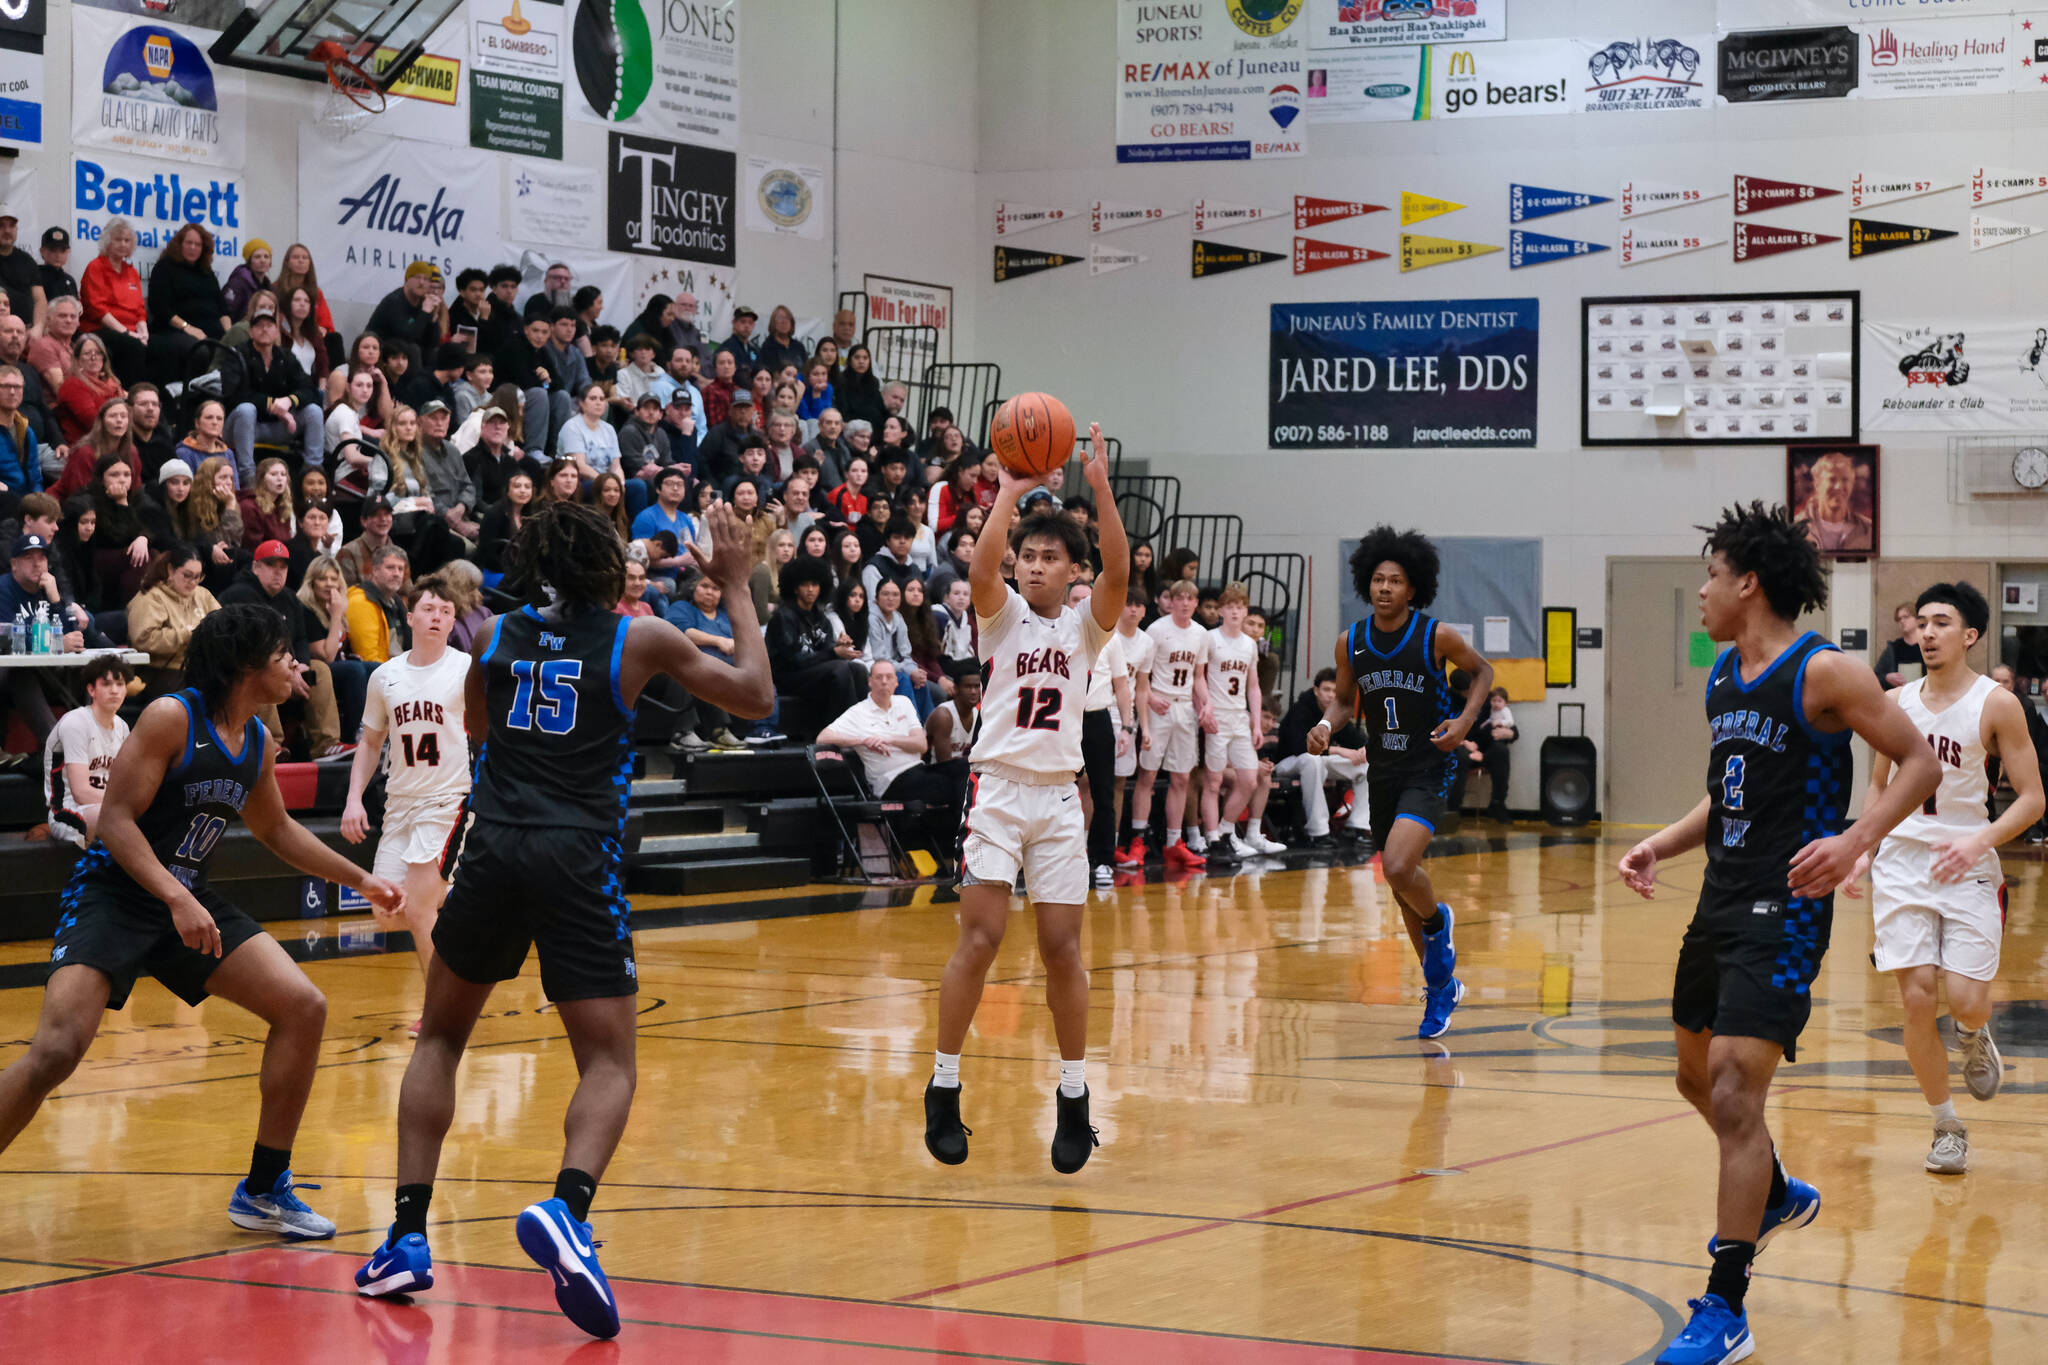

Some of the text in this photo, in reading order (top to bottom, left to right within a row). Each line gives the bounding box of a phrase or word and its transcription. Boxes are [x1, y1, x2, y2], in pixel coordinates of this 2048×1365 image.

[660, 0, 735, 44] JONES
[1138, 5, 1201, 24] JUNEAU
[488, 35, 497, 48] EL
[1136, 25, 1202, 44] SPORTS!
[148, 45, 169, 67] NAPA
[1903, 37, 2005, 61] Healing Hand
[1124, 60, 1210, 83] RE/MAX
[1214, 58, 1233, 77] of
[1238, 57, 1300, 79] Juneau
[9, 80, 29, 93] COOL
[475, 74, 498, 89] TEAM
[500, 78, 524, 94] WORK
[1445, 78, 1566, 113] go bears!
[101, 97, 219, 145] GLACIER AUTO PARTS
[1150, 102, 1234, 117] (907) 789-4794
[1150, 121, 1234, 138] GO BEARS!
[1255, 142, 1300, 155] RE/MAX
[75, 159, 239, 229] Bartlett
[1915, 182, 1931, 191] 57
[2002, 178, 2034, 188] CHAMPS
[337, 173, 465, 247] Alaska
[1146, 209, 1163, 219] 50
[1912, 229, 1931, 241] 57
[871, 295, 946, 330] Win For Life!
[1289, 311, 1518, 336] JUNEAU'S FAMILY DENTIST
[1278, 354, 1528, 403] JARED LEE, DDS
[1959, 397, 1985, 409] Club
[1274, 424, 1532, 443] (907) 586-1188 jaredleedds.com
[538, 630, 566, 651] FW
[1017, 647, 1071, 680] BEARS
[1172, 668, 1188, 686] 11
[1227, 676, 1240, 696] 3
[506, 658, 583, 735] 15
[395, 700, 443, 728] BEARS
[1015, 687, 1063, 732] 12
[1383, 697, 1400, 730] 1
[401, 732, 440, 768] 14
[1381, 732, 1410, 751] WAY
[1721, 754, 1746, 811] 2
[184, 779, 249, 812] FEDER
[175, 812, 227, 862] 10
[1721, 816, 1752, 848] WAY
